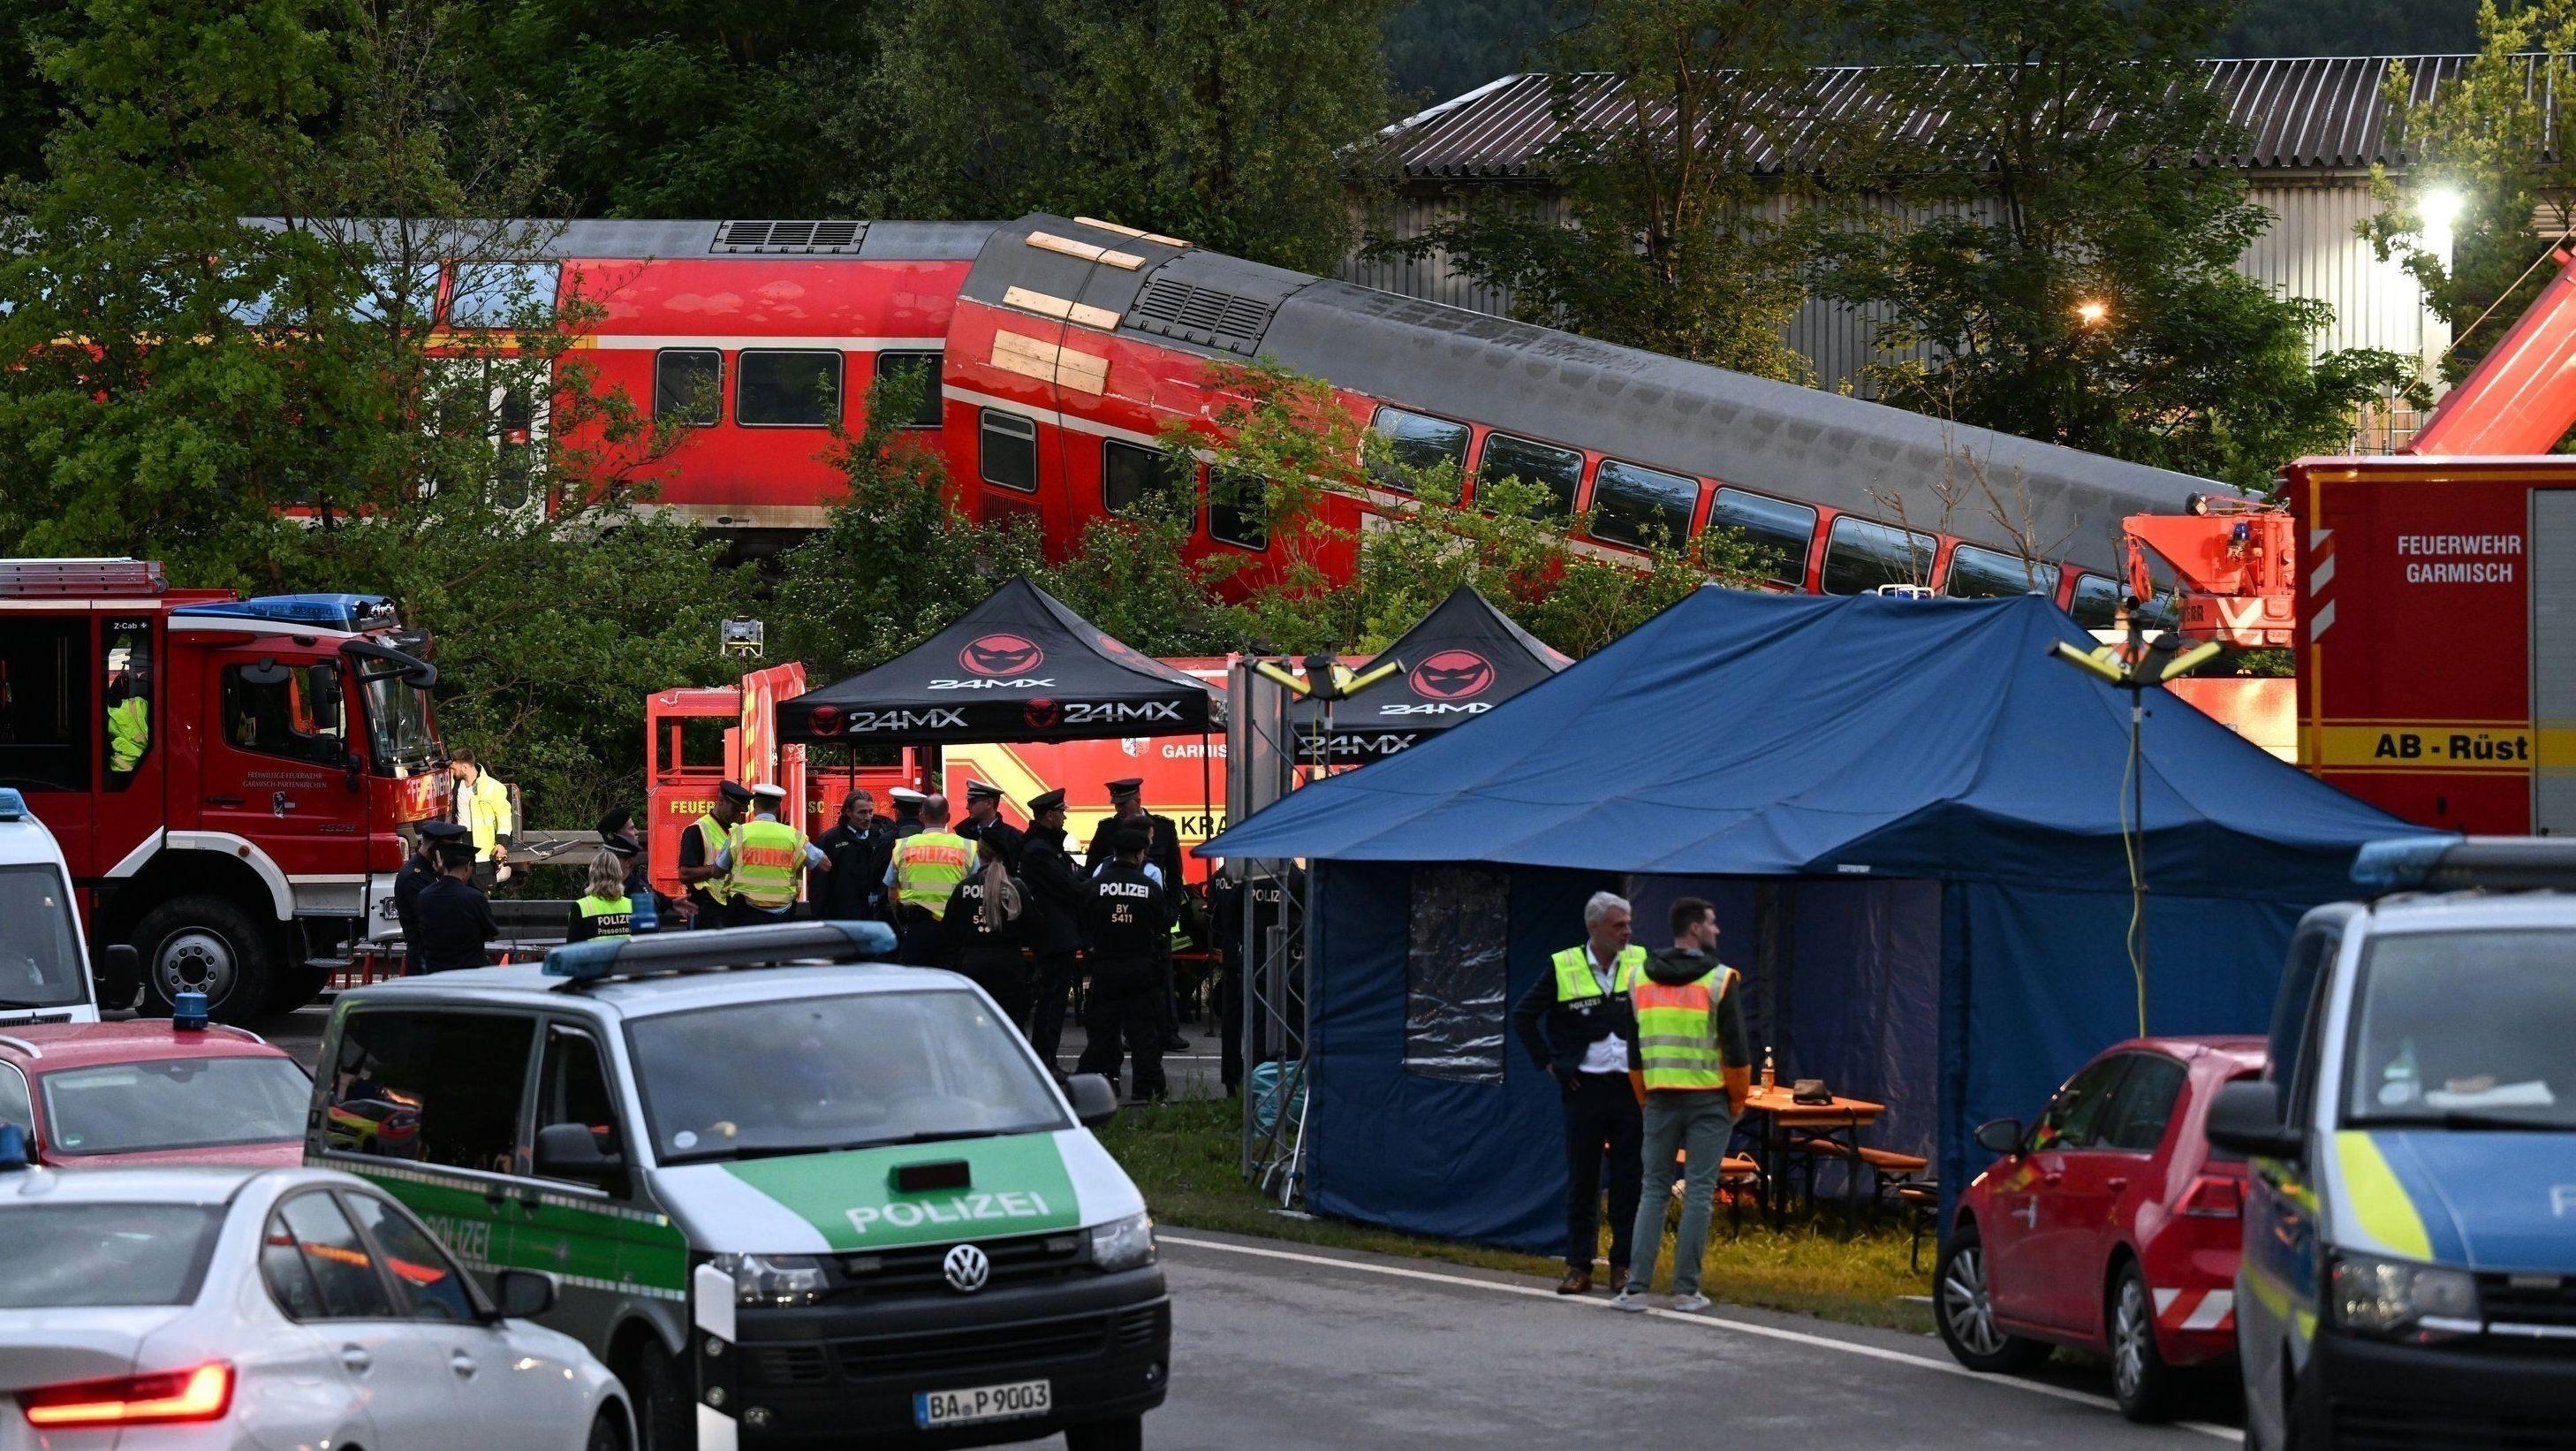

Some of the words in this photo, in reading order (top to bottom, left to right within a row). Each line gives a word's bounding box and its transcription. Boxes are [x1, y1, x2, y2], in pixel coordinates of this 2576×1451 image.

[2398, 536, 2522, 555] FEUERWEHR
[2406, 563, 2513, 583] GARMISCH
[928, 678, 1056, 690] 24MX
[849, 708, 969, 733] 24MX
[1064, 700, 1184, 723] 24MX
[1162, 744, 1227, 758] GARMIS
[1299, 734, 1417, 755] 24MX
[2374, 733, 2422, 758] AB
[2449, 733, 2529, 761] Rüst
[671, 801, 716, 814] FEUER
[1100, 882, 1148, 898] POLIZEI
[1111, 913, 1133, 923] 5411
[1116, 904, 1129, 914] BY
[597, 915, 631, 926] POLIZE
[845, 1191, 1052, 1234] POLIZEI
[929, 1394, 960, 1419] BA
[974, 1391, 989, 1414] P
[994, 1384, 1049, 1411] 9003
